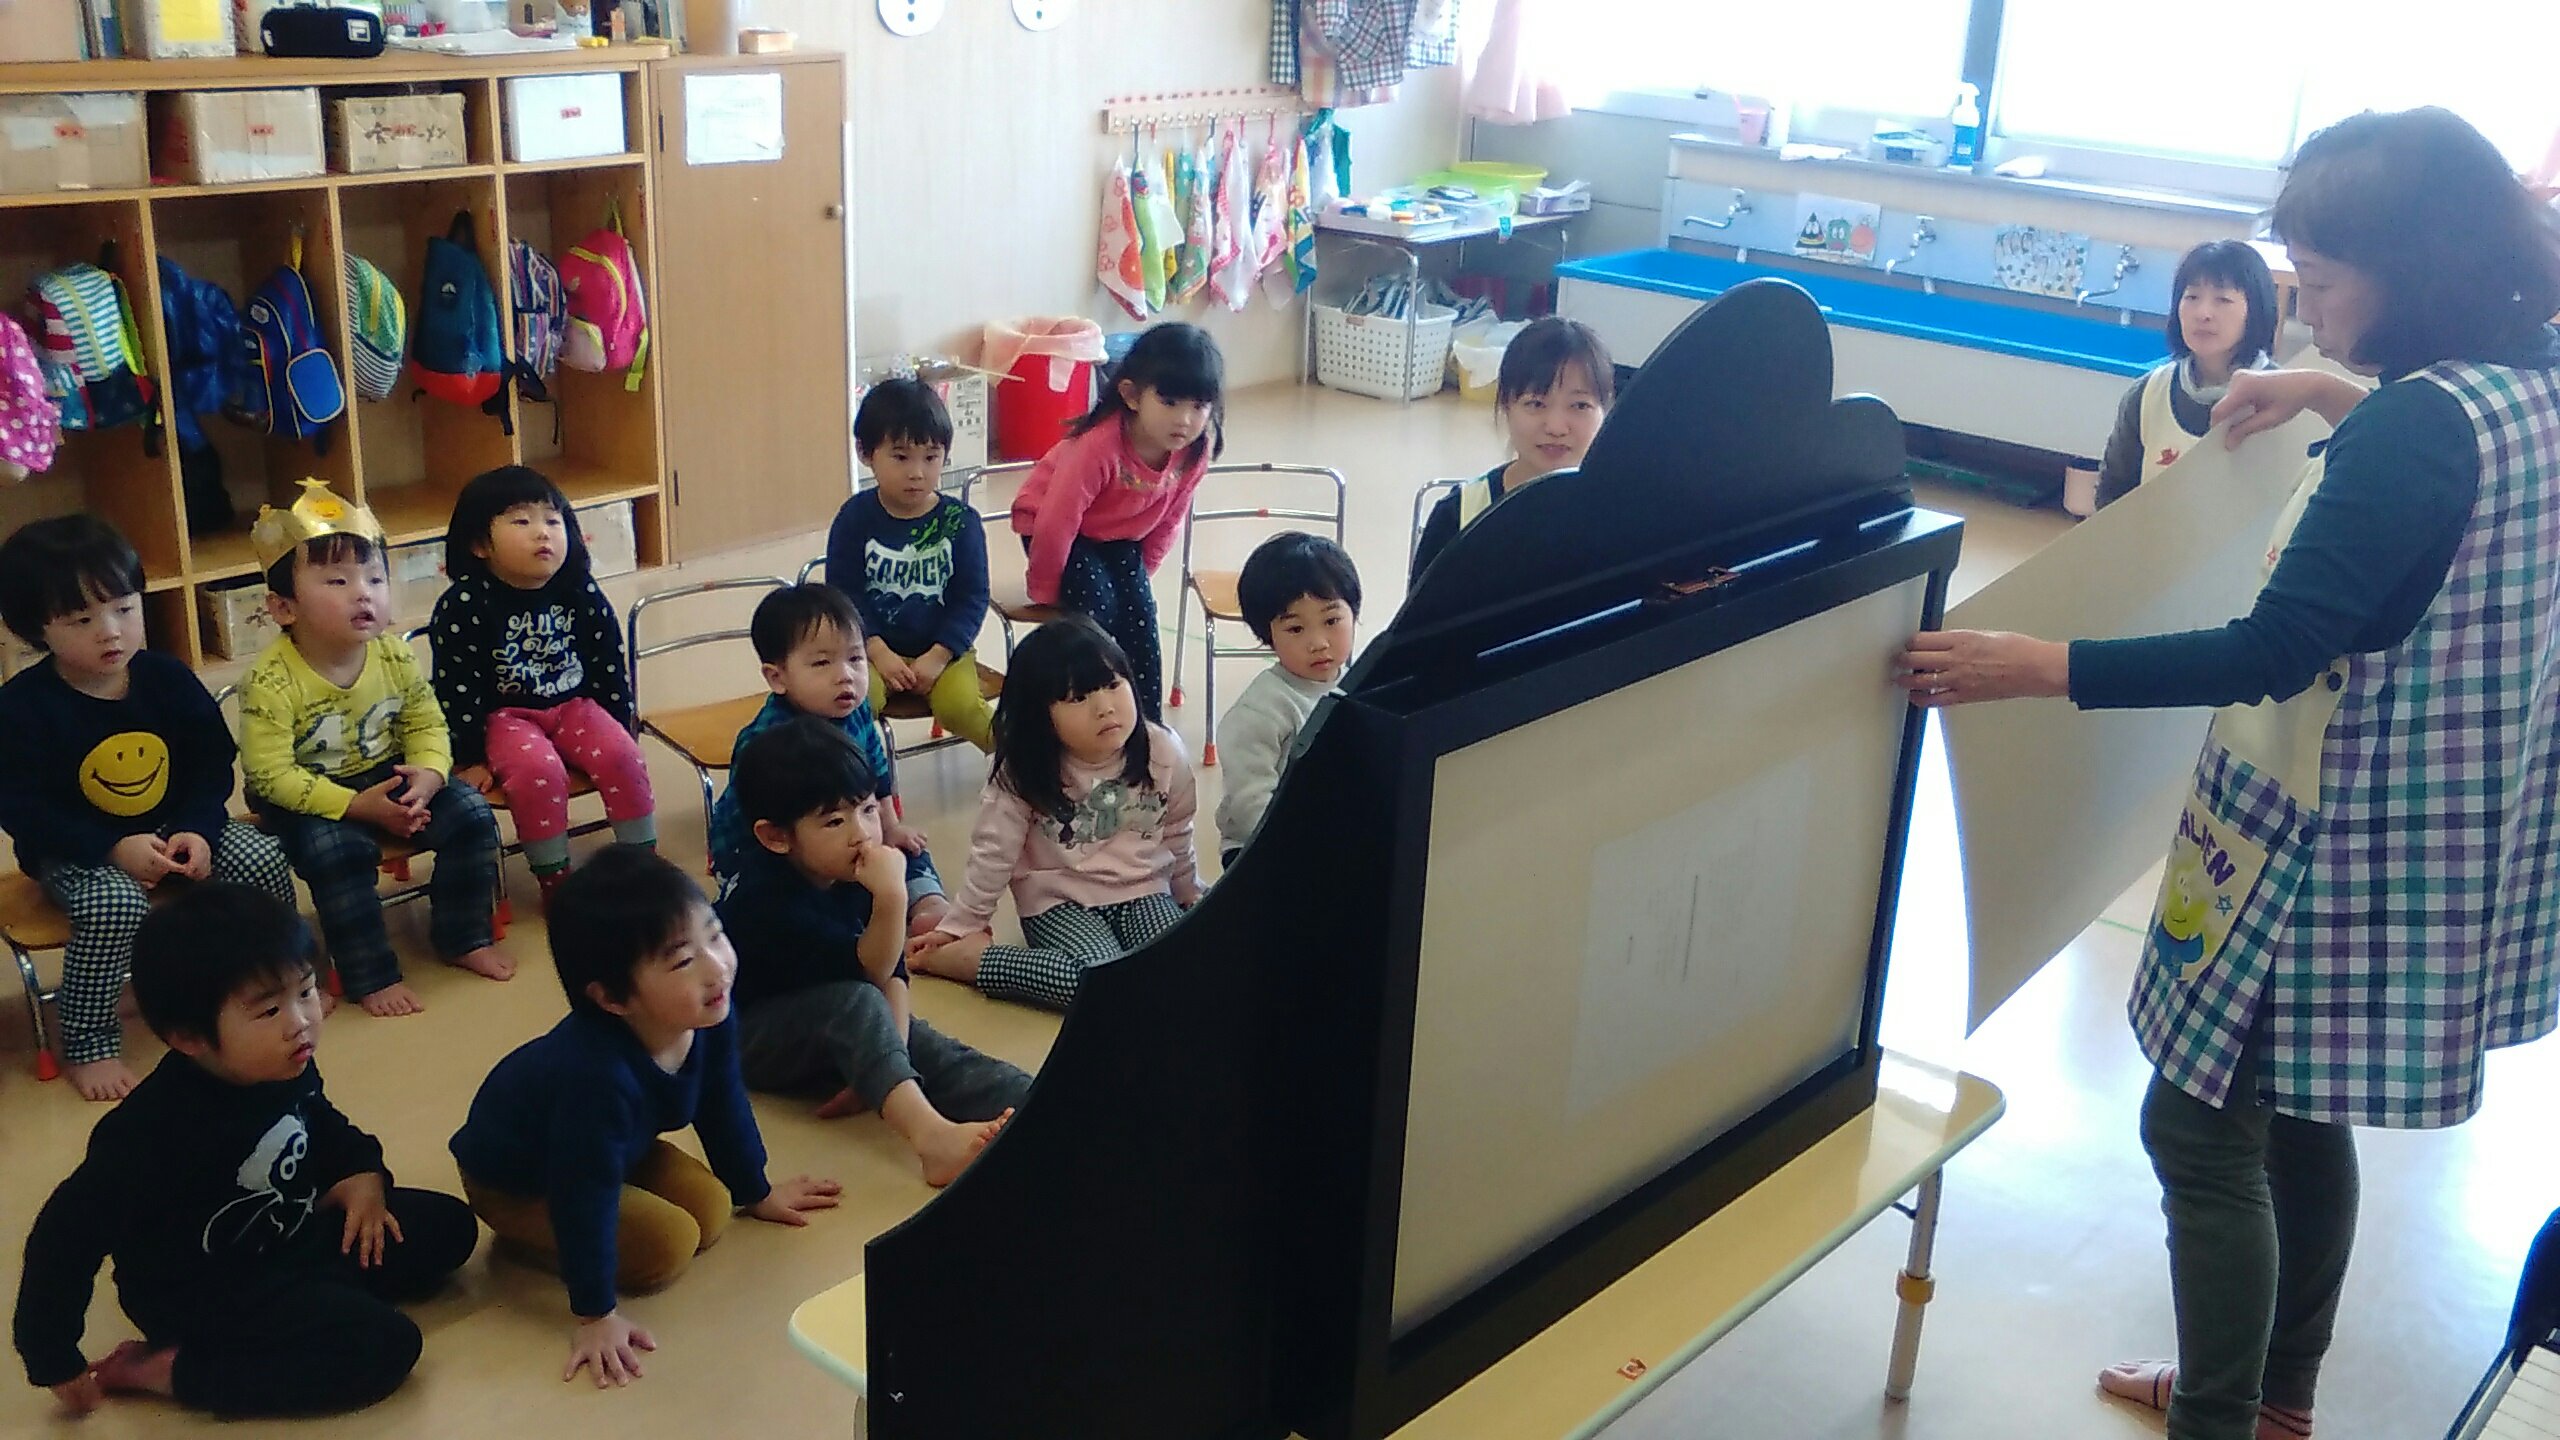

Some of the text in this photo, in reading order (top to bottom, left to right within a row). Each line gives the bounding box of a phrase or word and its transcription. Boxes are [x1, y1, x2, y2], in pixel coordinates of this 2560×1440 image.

[506, 611, 555, 640] All
[522, 634, 576, 660] Your
[495, 651, 578, 682] Friends
[2179, 807, 2236, 887] ALIEN
